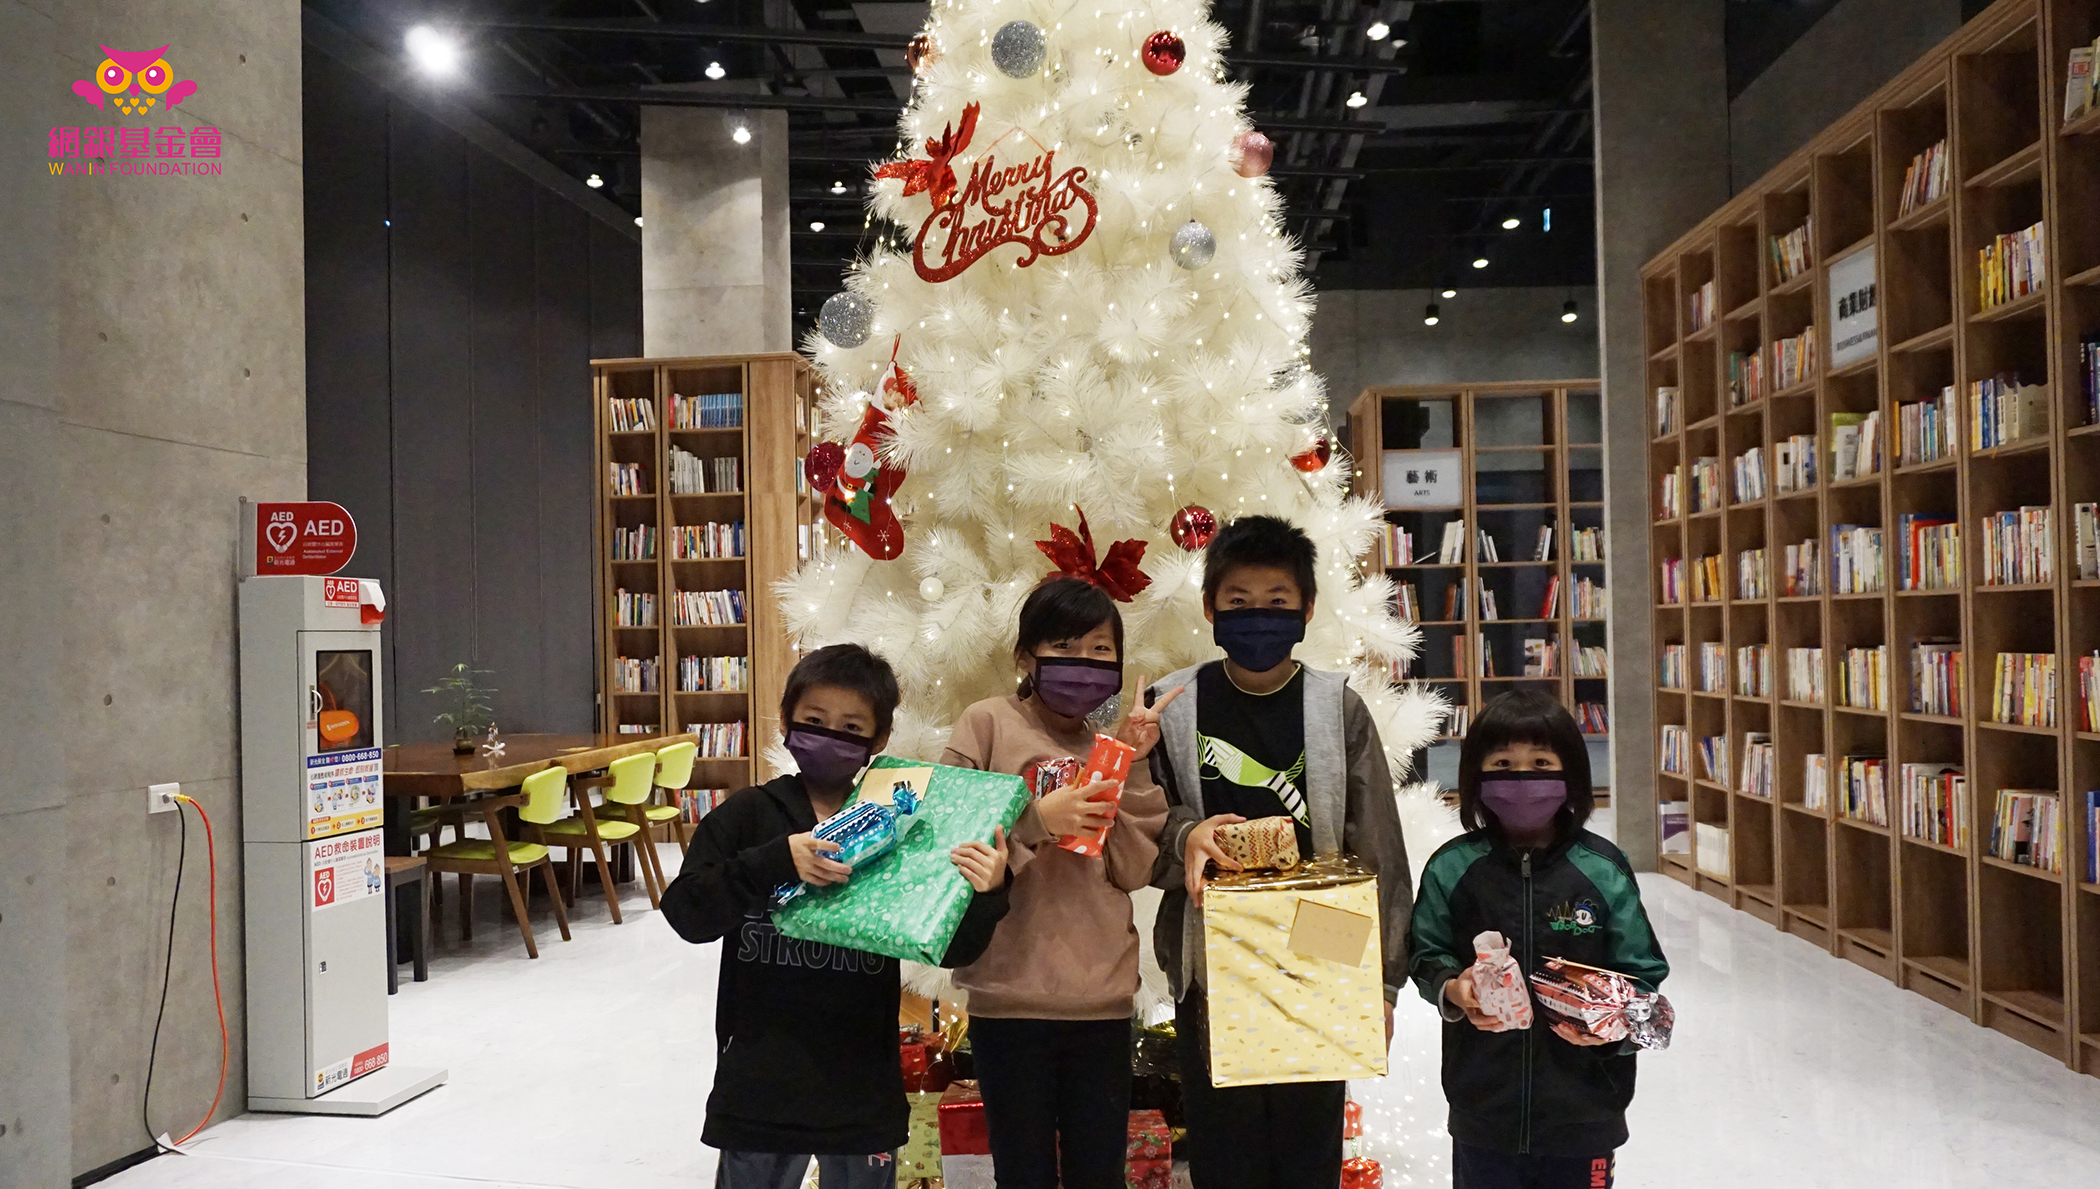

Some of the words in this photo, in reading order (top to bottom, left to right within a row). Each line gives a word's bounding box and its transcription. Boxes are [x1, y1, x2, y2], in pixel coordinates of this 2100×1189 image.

[949, 151, 1054, 212] Merry
[913, 167, 1098, 283] Christmas
[1405, 469, 1438, 484] 藝術
[270, 511, 294, 522] AED
[303, 519, 344, 536] AED
[336, 580, 358, 593] AED
[319, 870, 331, 880] AED
[1590, 1158, 1607, 1189] EM
